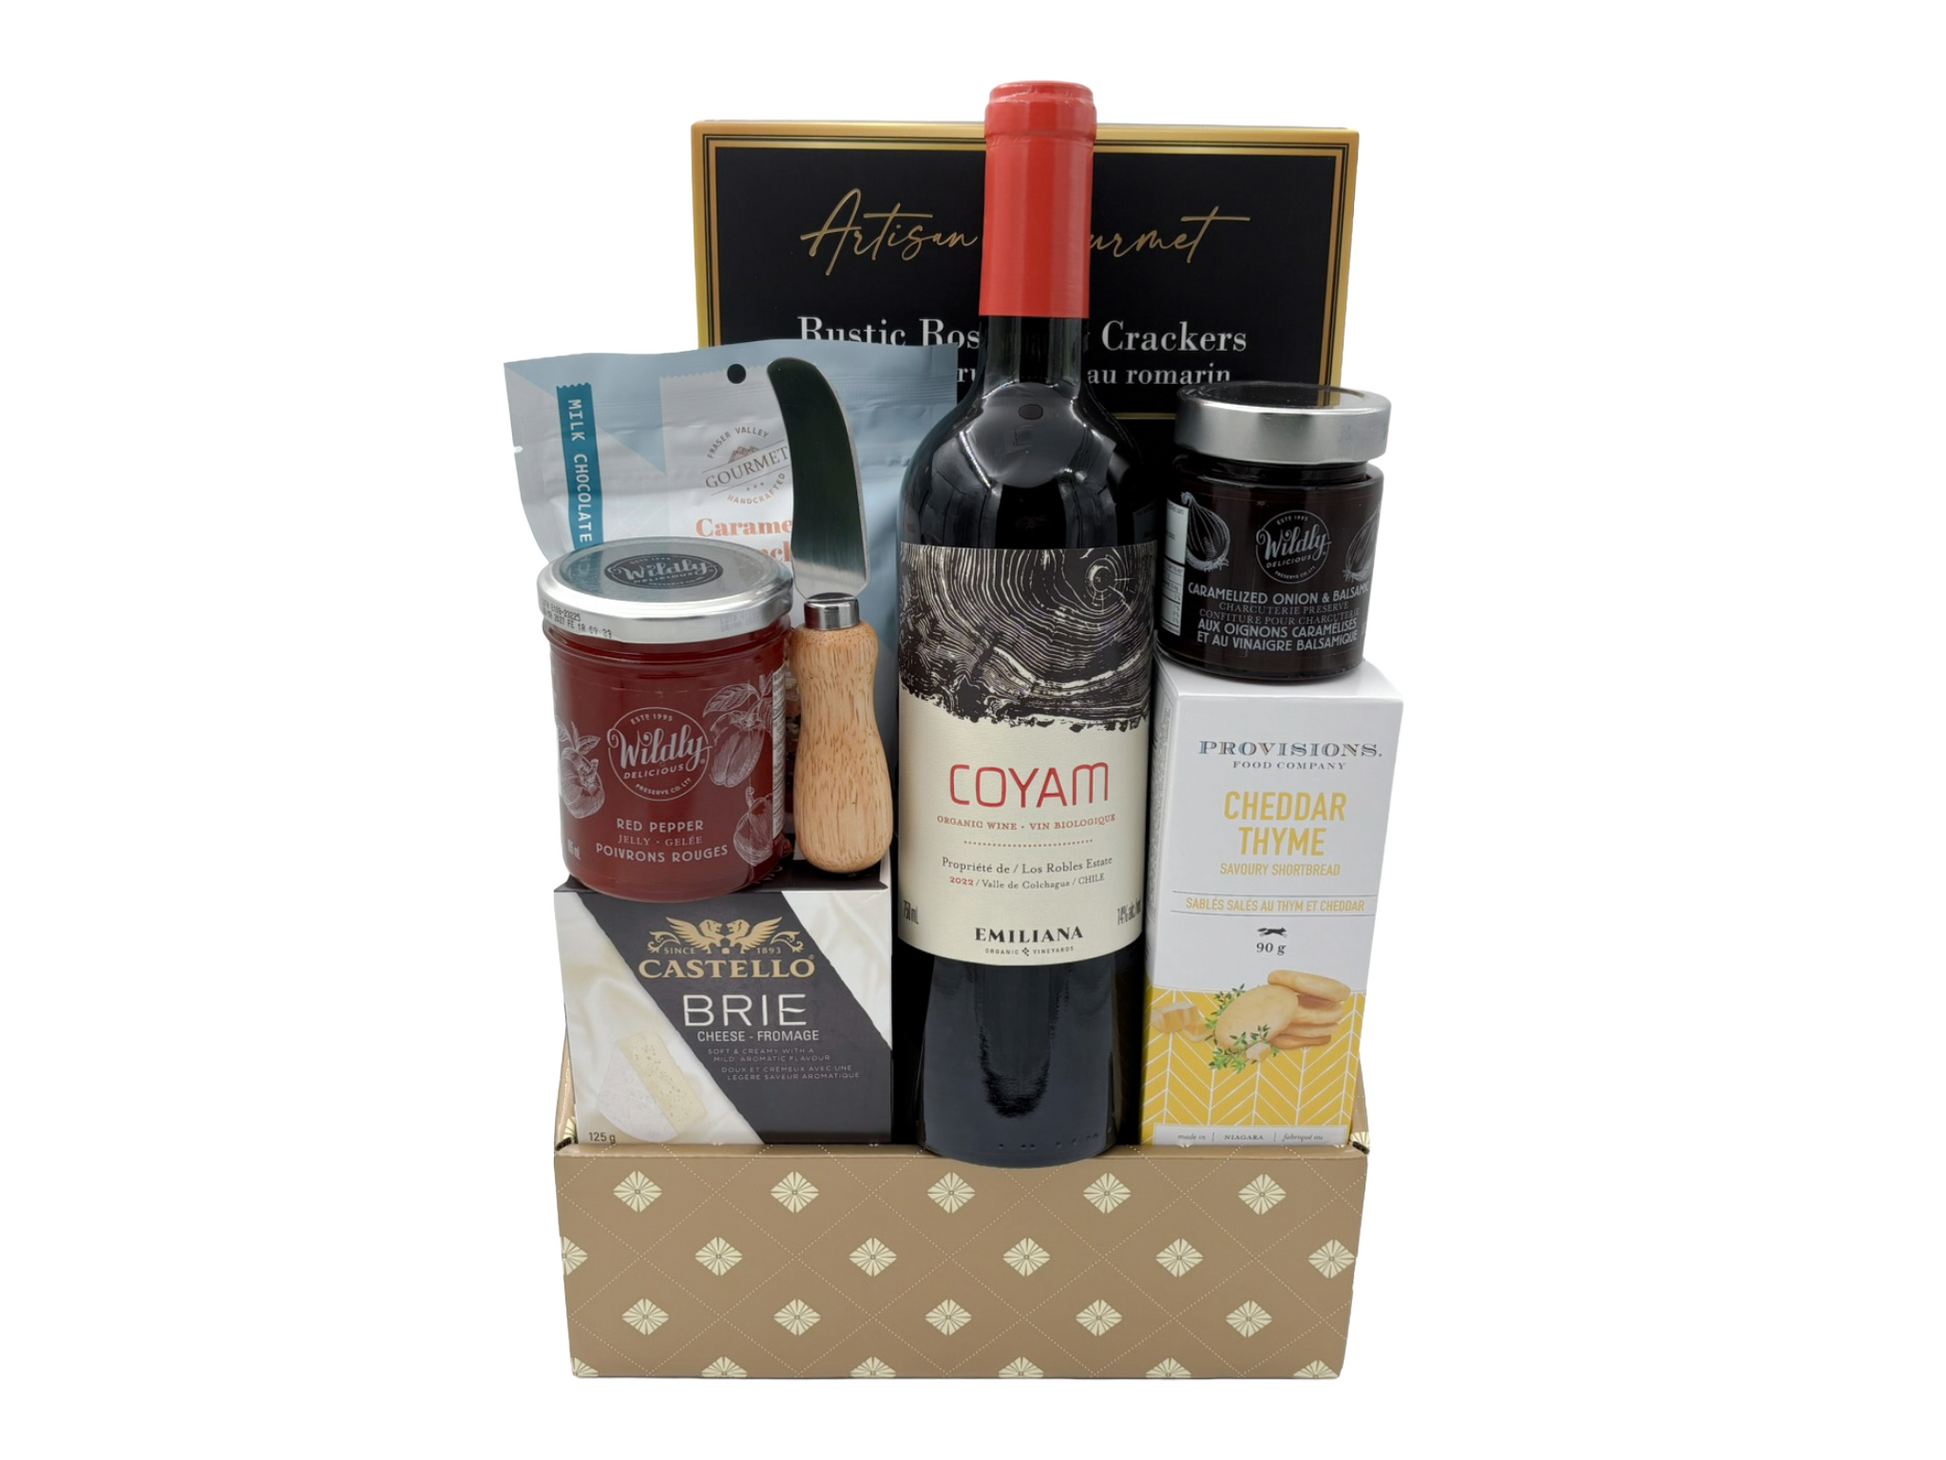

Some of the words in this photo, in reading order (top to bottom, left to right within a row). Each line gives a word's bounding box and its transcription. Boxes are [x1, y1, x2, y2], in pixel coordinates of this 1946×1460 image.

[800, 188, 977, 276] Artisan
[1090, 206, 1251, 263] urmet
[1101, 320, 1247, 352] Crackers
[1087, 369, 1117, 385] au
[1126, 362, 1231, 385] romarin
[568, 399, 586, 442] MILK
[707, 431, 731, 460] FRASER
[735, 426, 769, 439] VALLEY
[705, 445, 789, 488] GOURMET
[573, 453, 593, 543] CHOCOLATE
[727, 472, 786, 505] HANDCRAFTED
[695, 517, 793, 538] Carame
[1255, 523, 1332, 561] Wildly
[607, 559, 719, 580] Wildly
[1266, 554, 1312, 569] DELICIOUS
[1188, 582, 1268, 605] CARAMELIZED
[1273, 592, 1319, 605] ONION
[1321, 592, 1330, 604] &
[1199, 608, 1262, 625] CONFITURE
[1264, 616, 1295, 626] POUR
[1298, 607, 1360, 626] CHARCUTERIE
[1219, 601, 1301, 615] CHARCUTERIE
[1303, 601, 1349, 615] PRESERVE
[1198, 618, 1221, 633] AUX
[1224, 622, 1288, 639] OIGNONS
[1197, 631, 1210, 644] ET
[1212, 634, 1229, 647] AU
[1232, 636, 1293, 651] VINAIGRE
[1296, 629, 1359, 651] BALSAMIQUE
[607, 724, 713, 773] Wildly
[623, 764, 684, 779] DELICIOUS
[1233, 760, 1273, 770] FOOD
[1276, 760, 1347, 771] COMPANY
[635, 783, 669, 795] PRESERVE
[950, 762, 1109, 808] COYAM
[1223, 791, 1347, 822] CHEDDAR
[616, 818, 643, 832] RED
[649, 820, 704, 833] PEPPER
[936, 815, 984, 829] ORGANIC
[987, 821, 1018, 831] WINE
[1030, 821, 1051, 831] VIN
[1053, 813, 1117, 830] BIOLOGIQUE
[617, 834, 651, 847] JELLY
[665, 835, 703, 847] GELÉE
[1238, 826, 1328, 857] THYME
[596, 843, 665, 863] POIVRONS
[672, 844, 728, 863] ROUGES
[942, 856, 993, 875] Propriété
[996, 863, 1011, 874] de
[1022, 863, 1043, 874] Los
[1046, 860, 1083, 874] Robles
[1086, 855, 1114, 869] Estate
[1219, 862, 1270, 877] SAVOURY
[1271, 863, 1341, 877] SHORTBREAD
[949, 875, 974, 887] 2022
[982, 878, 1005, 889] Valle
[1007, 880, 1019, 890] de
[1022, 879, 1071, 891] Colchagua
[1078, 872, 1106, 886] CHILE
[1185, 896, 1225, 911] SABLÉS
[1226, 898, 1259, 912] SALÉS
[1260, 900, 1275, 912] AU
[1276, 900, 1304, 912] THYM
[1306, 900, 1319, 912] ET
[1319, 900, 1365, 912] CHEDDAR
[974, 925, 1084, 944] EMILIANA
[663, 946, 696, 956] SINCE
[756, 946, 782, 956] 1893
[984, 947, 1020, 955] ORGANIC
[1032, 945, 1074, 955] VINEYARDS
[1256, 942, 1274, 953] 90
[1277, 944, 1287, 956] g
[638, 958, 816, 979] CASTELLO
[682, 993, 807, 1027] BRIE
[697, 1030, 746, 1043] CHEESE
[757, 1029, 820, 1042] FROMAGE
[789, 1054, 831, 1062] FLAVOUR
[764, 1073, 799, 1081] SAVEUR
[801, 1072, 860, 1080] AROMATIQUE
[834, 1064, 853, 1072] UNE
[589, 1132, 607, 1143] 125
[607, 1133, 616, 1144] g
[1177, 1133, 1197, 1141] made
[1198, 1133, 1206, 1141] in
